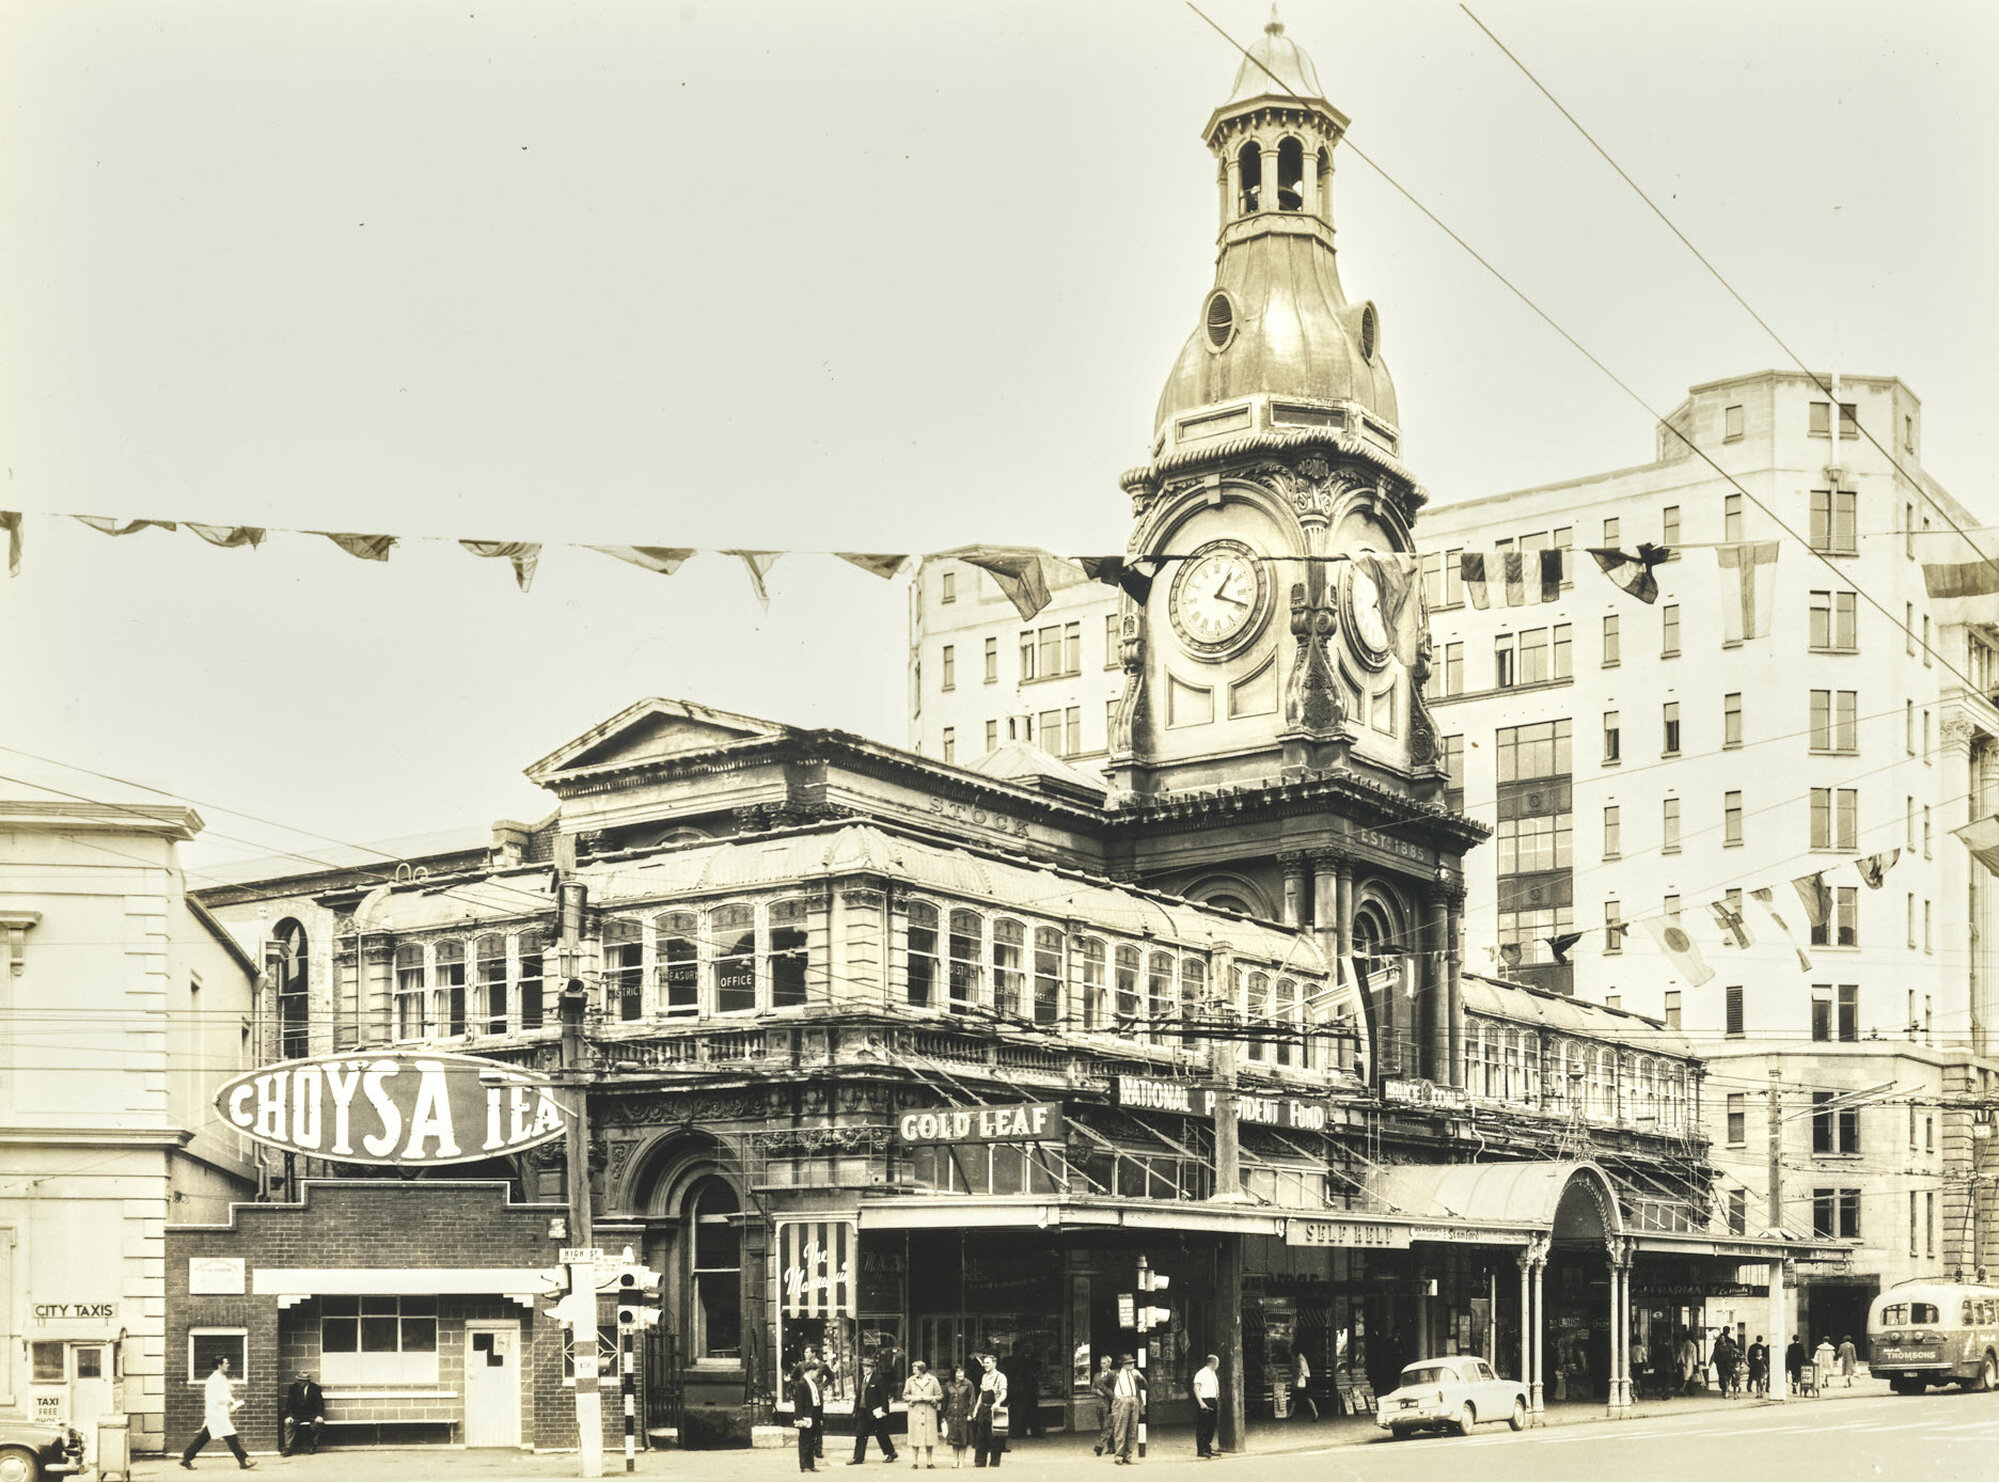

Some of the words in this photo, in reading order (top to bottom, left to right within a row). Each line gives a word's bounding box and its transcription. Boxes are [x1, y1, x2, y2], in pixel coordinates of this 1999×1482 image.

[929, 796, 1030, 836] STOCK
[1394, 839, 1424, 860] 1885
[720, 974, 752, 988] OFFICE
[228, 1059, 462, 1159] CHOYSA
[479, 1067, 564, 1150] TEA
[1119, 1075, 1193, 1112] NATIONAL
[1289, 1099, 1324, 1130] FUND
[901, 1113, 971, 1141] GOLD
[979, 1106, 1048, 1139] LEAF
[1306, 1224, 1346, 1243] SELF
[1354, 1225, 1393, 1245] HELP
[803, 1241, 828, 1268] The
[784, 1262, 850, 1298] Mannequin
[35, 1304, 68, 1317] CITY
[74, 1304, 113, 1317] TAXIS
[1886, 1351, 1936, 1360] THOMSONS
[37, 1398, 59, 1406] TAXI
